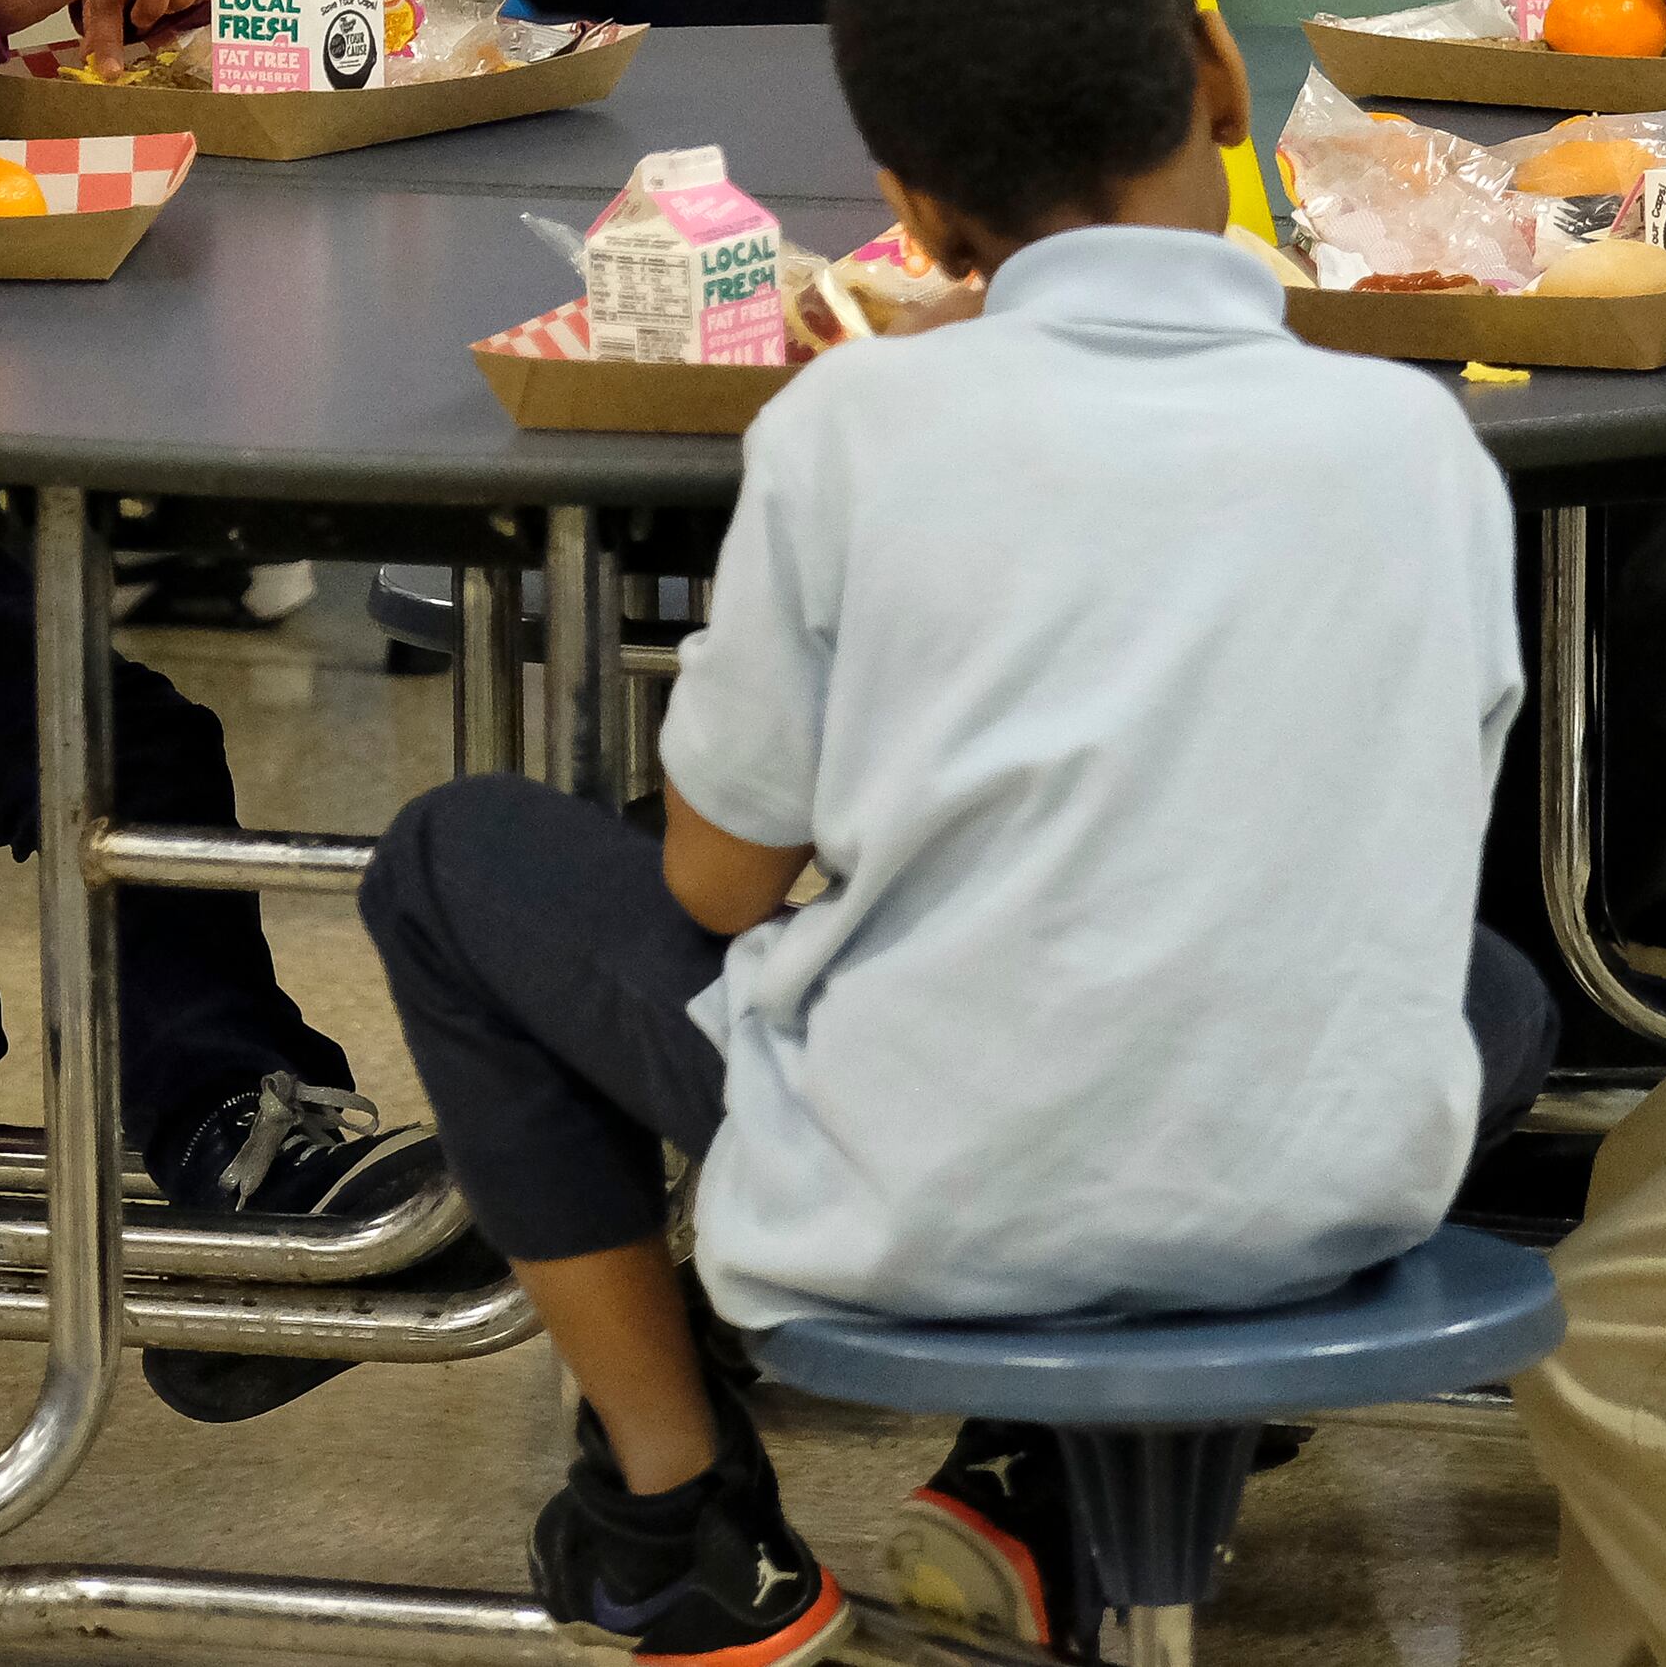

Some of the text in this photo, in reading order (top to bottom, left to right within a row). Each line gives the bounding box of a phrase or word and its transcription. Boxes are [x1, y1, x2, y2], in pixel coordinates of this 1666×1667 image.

[219, 14, 299, 42] FRESH
[218, 49, 301, 69] FAT FREE
[219, 69, 300, 83] STRAWBERRY
[701, 235, 776, 276] LOCAL
[703, 264, 776, 308] FRESH
[707, 309, 735, 333] FAT
